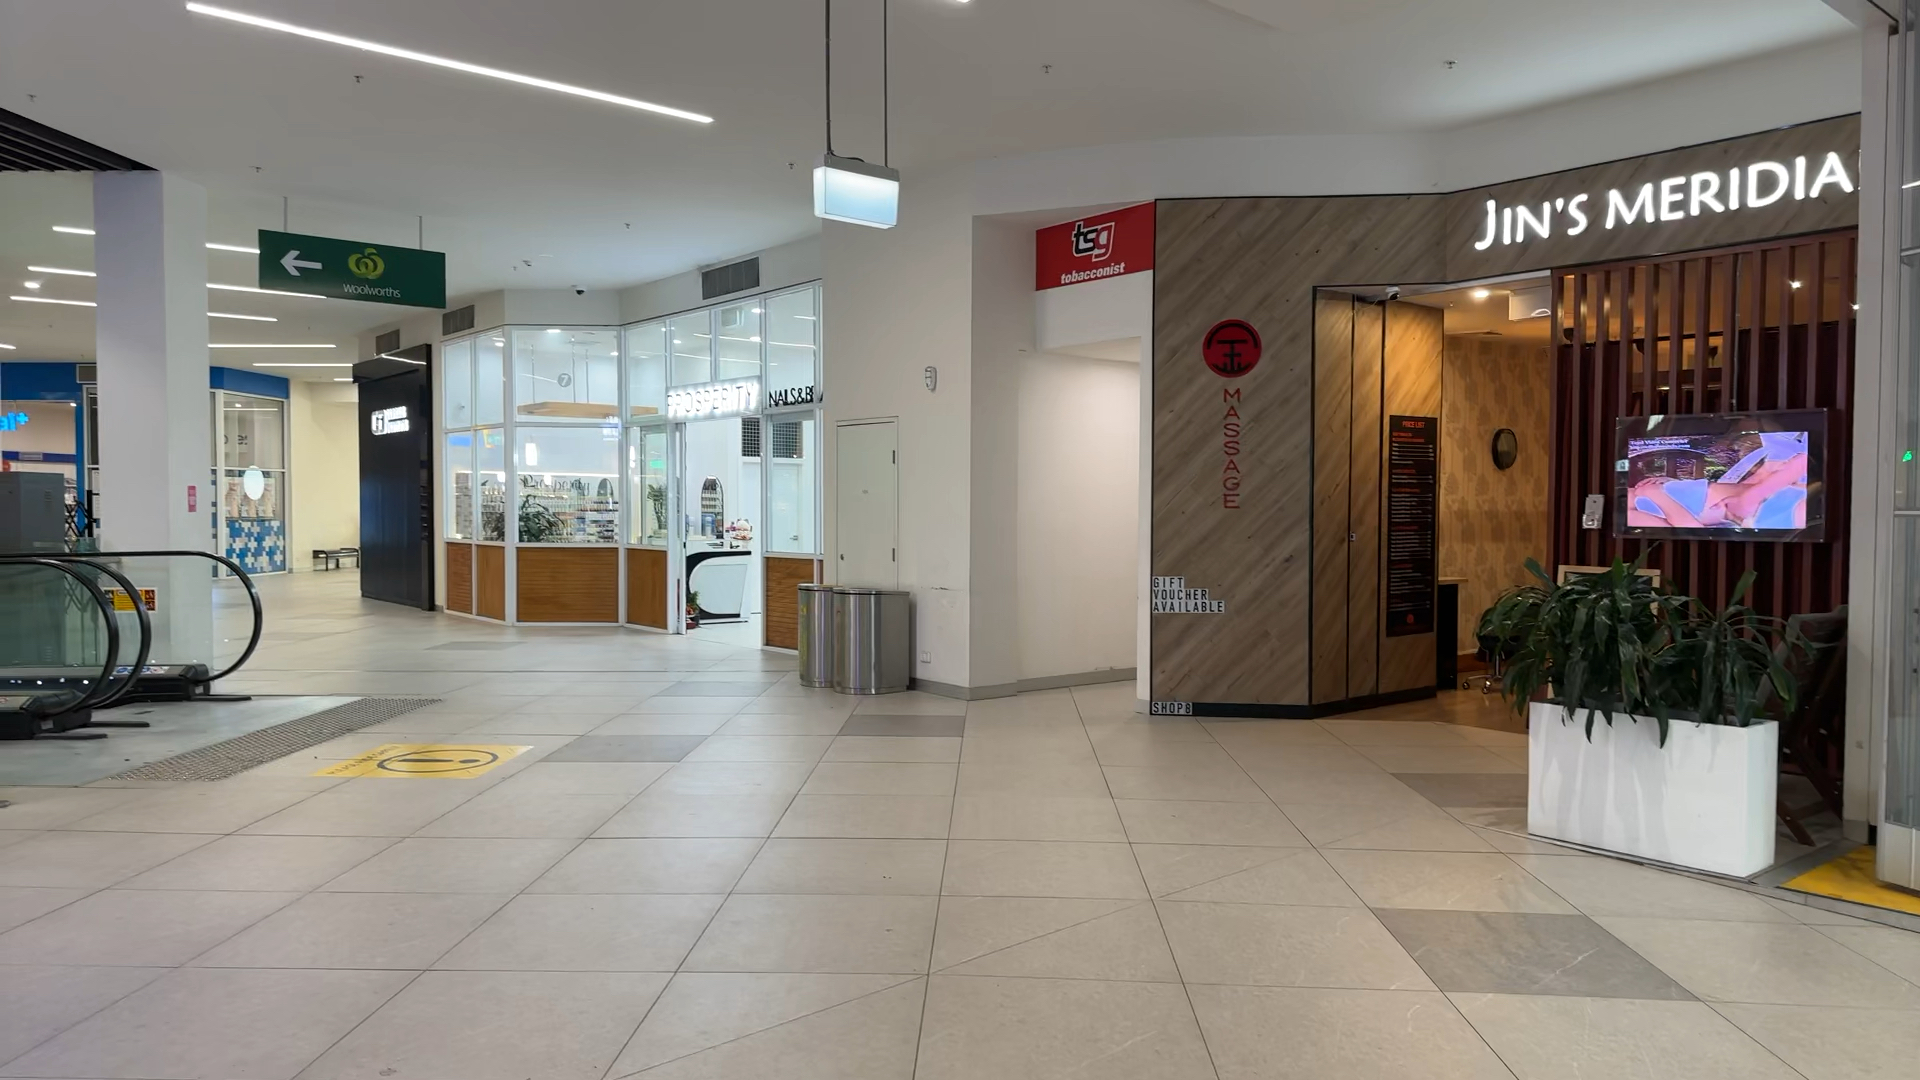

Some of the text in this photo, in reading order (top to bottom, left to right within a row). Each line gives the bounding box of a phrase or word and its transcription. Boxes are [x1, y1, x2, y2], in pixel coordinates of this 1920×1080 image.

[1475, 151, 1860, 251] JIN'S MERIDIA
[1071, 221, 1115, 262] tsg
[1061, 261, 1125, 284] tobacconist
[343, 283, 401, 298] Woolworths
[561, 375, 569, 386] 7
[667, 383, 758, 417] PROSPERITY
[1223, 387, 1241, 509] MASSAGE
[1153, 577, 1183, 588] GIFT
[1153, 589, 1207, 600] VOUCHER
[1153, 601, 1223, 612] AVAILABLE
